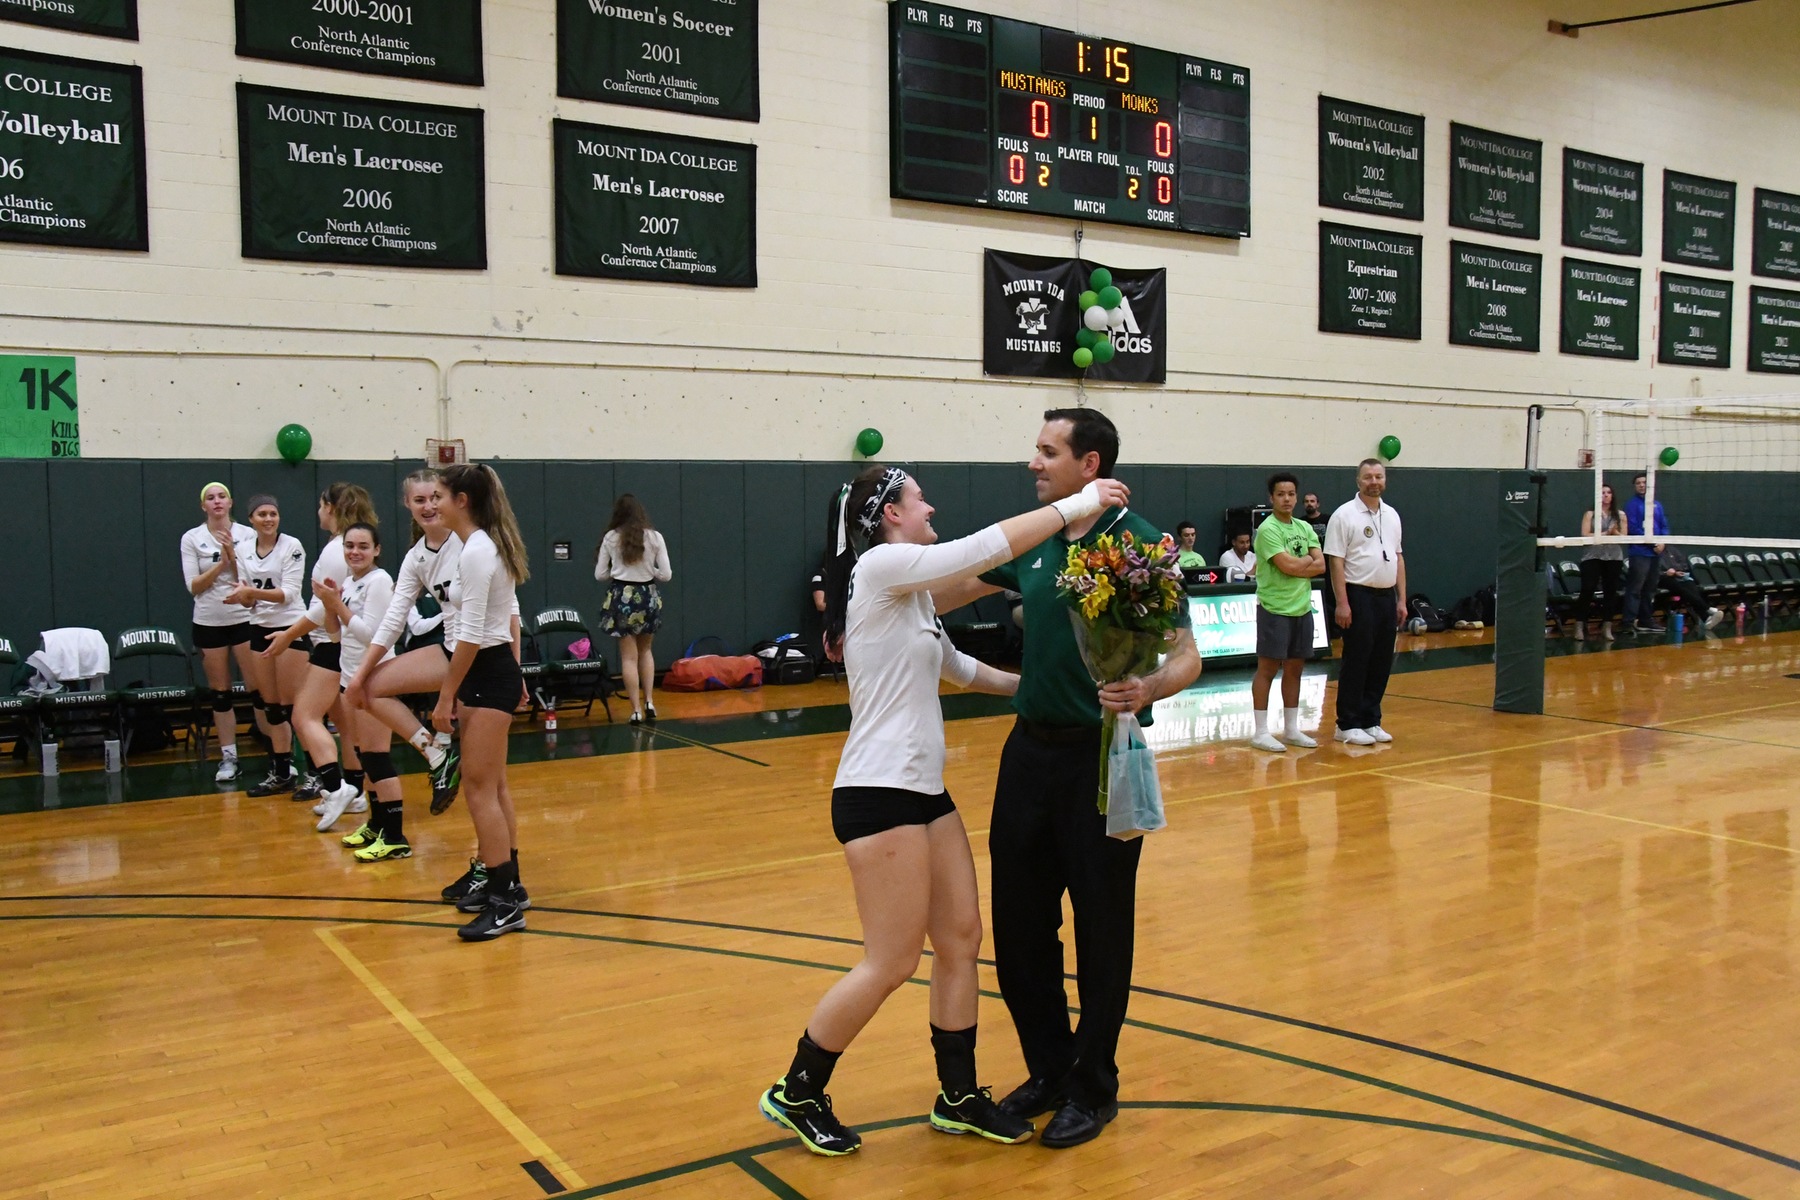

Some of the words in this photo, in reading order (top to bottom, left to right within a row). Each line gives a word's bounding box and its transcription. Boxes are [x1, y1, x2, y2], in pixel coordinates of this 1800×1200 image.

[0, 0, 75, 14] mpions
[588, 0, 667, 26] Women's
[672, 11, 734, 37] Soccer
[907, 8, 928, 23] PLYR
[939, 14, 954, 29] FLS
[967, 19, 982, 34] PTS
[318, 25, 357, 43] North
[360, 33, 410, 50] Atlantic
[291, 36, 363, 57] Conference
[366, 47, 436, 66] Champions
[641, 42, 681, 65] 2001
[625, 69, 656, 84] North
[658, 75, 698, 90] Atlantic
[1001, 70, 1066, 98] MUSTANGS
[1185, 63, 1202, 77] PLYR
[1210, 68, 1222, 81] FLS
[1232, 72, 1245, 86] PTS
[4, 73, 113, 103] COLLEGE
[602, 78, 662, 96] Conference
[664, 88, 720, 105] Champions
[1073, 93, 1106, 110] PERIOD
[1122, 92, 1159, 115] MONKS
[267, 104, 337, 126] MOUNT
[342, 111, 374, 130] IDA
[378, 115, 458, 138] COLLEGE
[1031, 100, 1049, 139] 0
[1091, 116, 1097, 140] 1
[1332, 110, 1362, 127] MOUNT
[1363, 116, 1377, 129] IDA
[1378, 119, 1413, 136] COLLEGE
[998, 137, 1028, 154] FOULS
[1155, 121, 1171, 158] 0
[1327, 131, 1371, 152] Women's
[1372, 140, 1418, 161] Volleyball
[1460, 135, 1487, 151] MOUNT
[1488, 141, 1501, 154] IDA
[1502, 145, 1533, 161] COLLEGE
[287, 141, 347, 166] Men's
[353, 148, 443, 174] Lacrosse
[576, 139, 636, 161] MOUNT
[639, 147, 667, 164] IDA
[669, 151, 738, 172] COLLEGE
[1058, 146, 1093, 163] PLAYER
[1097, 152, 1120, 167] FOUL
[1009, 154, 1025, 185] 0
[1038, 165, 1050, 187] 2
[1147, 160, 1175, 175] FOULS
[1362, 165, 1385, 181] 2002
[1458, 156, 1496, 176] Women's
[1497, 164, 1535, 184] Volleyball
[592, 173, 642, 195] Men's
[648, 180, 725, 203] Lacrosse
[997, 190, 1028, 205] SCORE
[1128, 178, 1138, 199] 2
[1158, 176, 1171, 205] 0
[1355, 185, 1370, 196] North
[1371, 187, 1393, 200] Atlantic
[1487, 188, 1507, 203] 2003
[0, 194, 53, 211] tlantic
[342, 188, 393, 210] 2006
[1074, 199, 1106, 214] MATCH
[1343, 191, 1373, 206] Conference
[1374, 197, 1404, 210] Champions
[0, 208, 86, 229] Champions
[639, 215, 679, 235] 2007
[1147, 208, 1175, 223] SCORE
[326, 218, 362, 233] North
[364, 221, 411, 236] Atlantic
[297, 231, 368, 247] Conference
[371, 234, 437, 252] Champions
[621, 243, 652, 257] North
[655, 246, 697, 259] Atlantic
[1330, 233, 1362, 249] MOUNT
[1363, 240, 1377, 251] IDA
[1377, 243, 1414, 256] COLLEGE
[601, 253, 657, 269] Conference
[660, 258, 717, 274] Champions
[1347, 259, 1398, 279] Equestrian
[1460, 253, 1487, 268] MOUNT
[1488, 258, 1501, 269] IDA
[1501, 259, 1533, 273] COLLEGE
[1466, 275, 1490, 290] Men's
[1492, 279, 1527, 295] Lacrosse
[1571, 268, 1594, 280] MOUNT
[1606, 274, 1635, 286] COLLEGE
[1002, 279, 1043, 296] MOUNT
[1047, 282, 1065, 301] IDA
[1348, 286, 1370, 301] 2007
[1376, 289, 1396, 304] 2008
[1577, 289, 1596, 302] Men's
[1597, 292, 1628, 307] Lacrosse
[1351, 304, 1364, 313] Zone
[1371, 306, 1388, 316] Region
[1487, 303, 1507, 317] 2008
[1673, 302, 1692, 315] Men's
[1693, 305, 1721, 318] Lacrosse
[1358, 318, 1387, 329] Champions
[1479, 321, 1494, 331] North
[1593, 315, 1610, 327] 2009
[1006, 338, 1061, 354] MUSTANGS
[1108, 330, 1152, 354] idas
[18, 367, 77, 411] 1K
[51, 419, 79, 439] KILLS
[51, 440, 80, 457] DIGS
[536, 610, 564, 626] MOUNT
[565, 610, 580, 623] IDA
[121, 629, 156, 648] MOUNT
[158, 630, 176, 646] IDA
[563, 661, 601, 671] MUSTANGS
[55, 694, 107, 704] MUSTANGS
[137, 690, 186, 700] MUSTANGS
